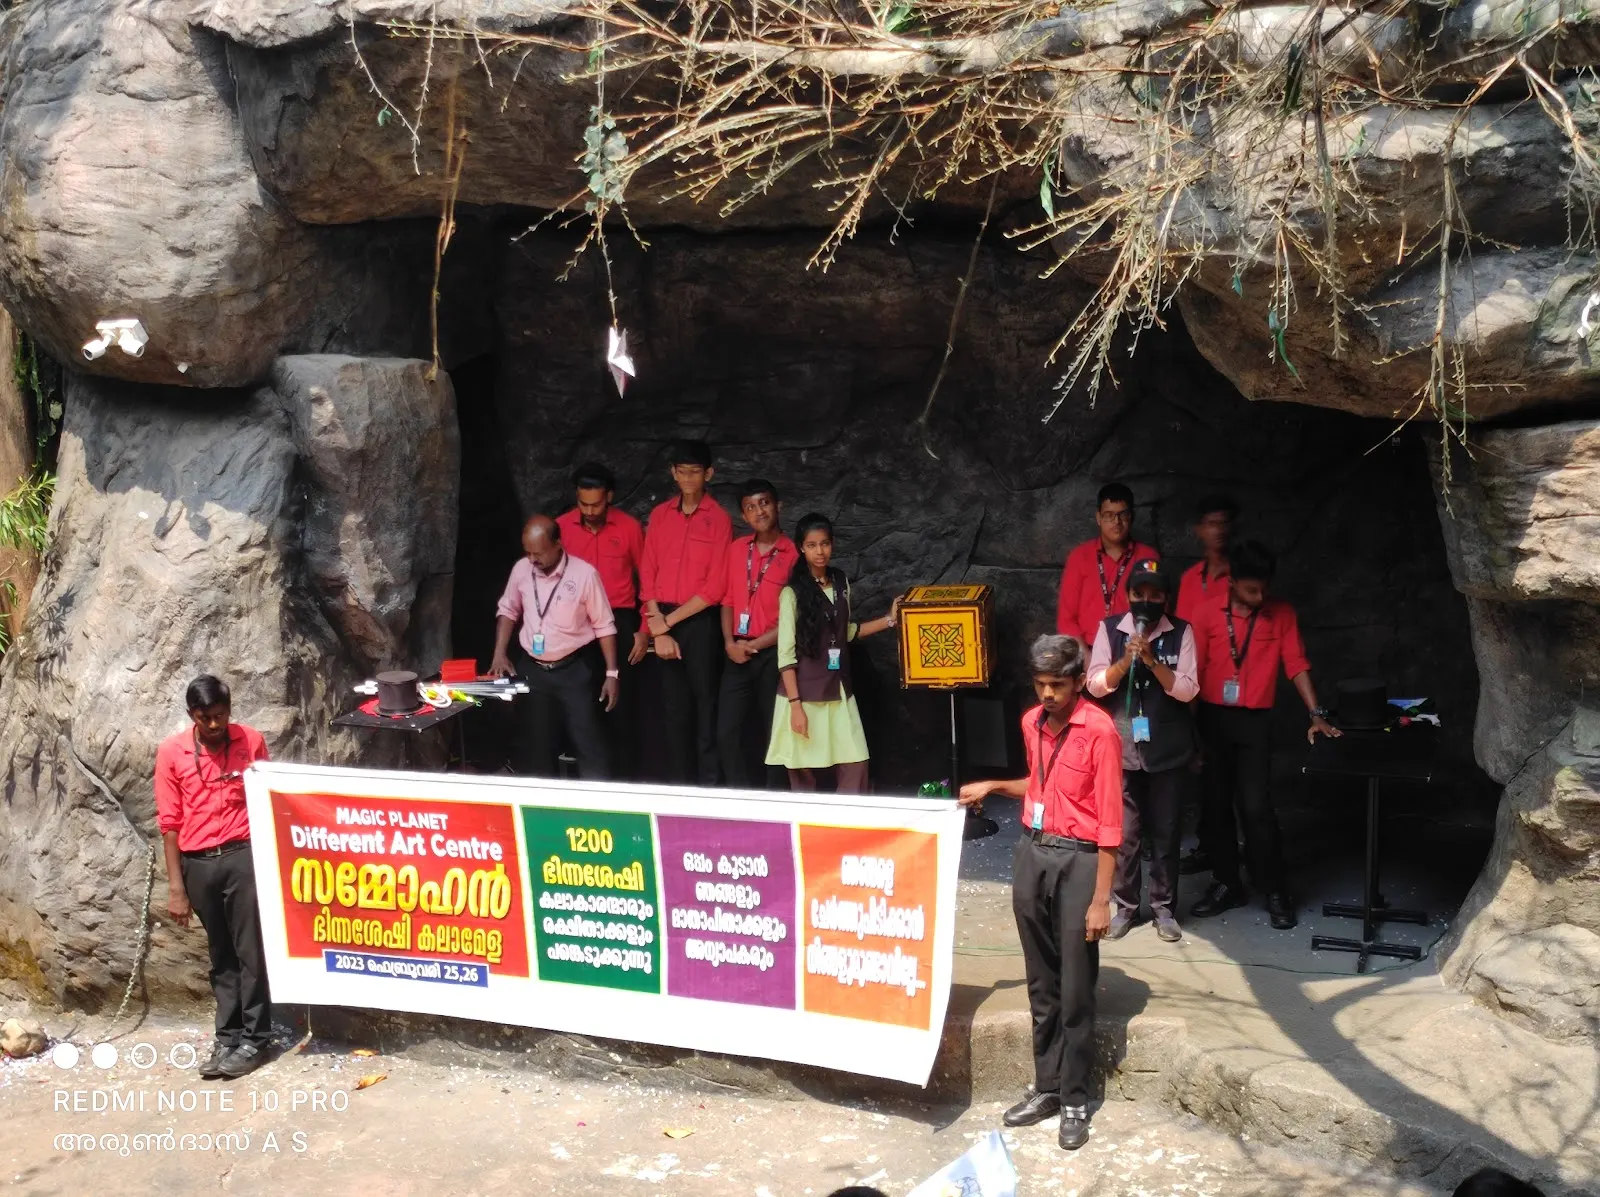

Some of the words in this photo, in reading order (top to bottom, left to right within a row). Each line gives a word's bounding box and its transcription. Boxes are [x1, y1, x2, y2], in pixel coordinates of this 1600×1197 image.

[335, 807, 385, 827] MAGIC
[389, 811, 448, 831] PLANET
[290, 825, 385, 854] Different
[390, 831, 426, 856] Art
[431, 834, 503, 861] Centre
[565, 827, 613, 853] 1200
[291, 857, 511, 919] സമ്മോഹൻ
[542, 855, 645, 892] ഭിന്നശേഷി
[313, 905, 412, 950] ഭിന്നശേഷി
[417, 922, 503, 964] കലാമേള
[335, 954, 365, 971] 2023
[443, 965, 479, 983] 25,26
